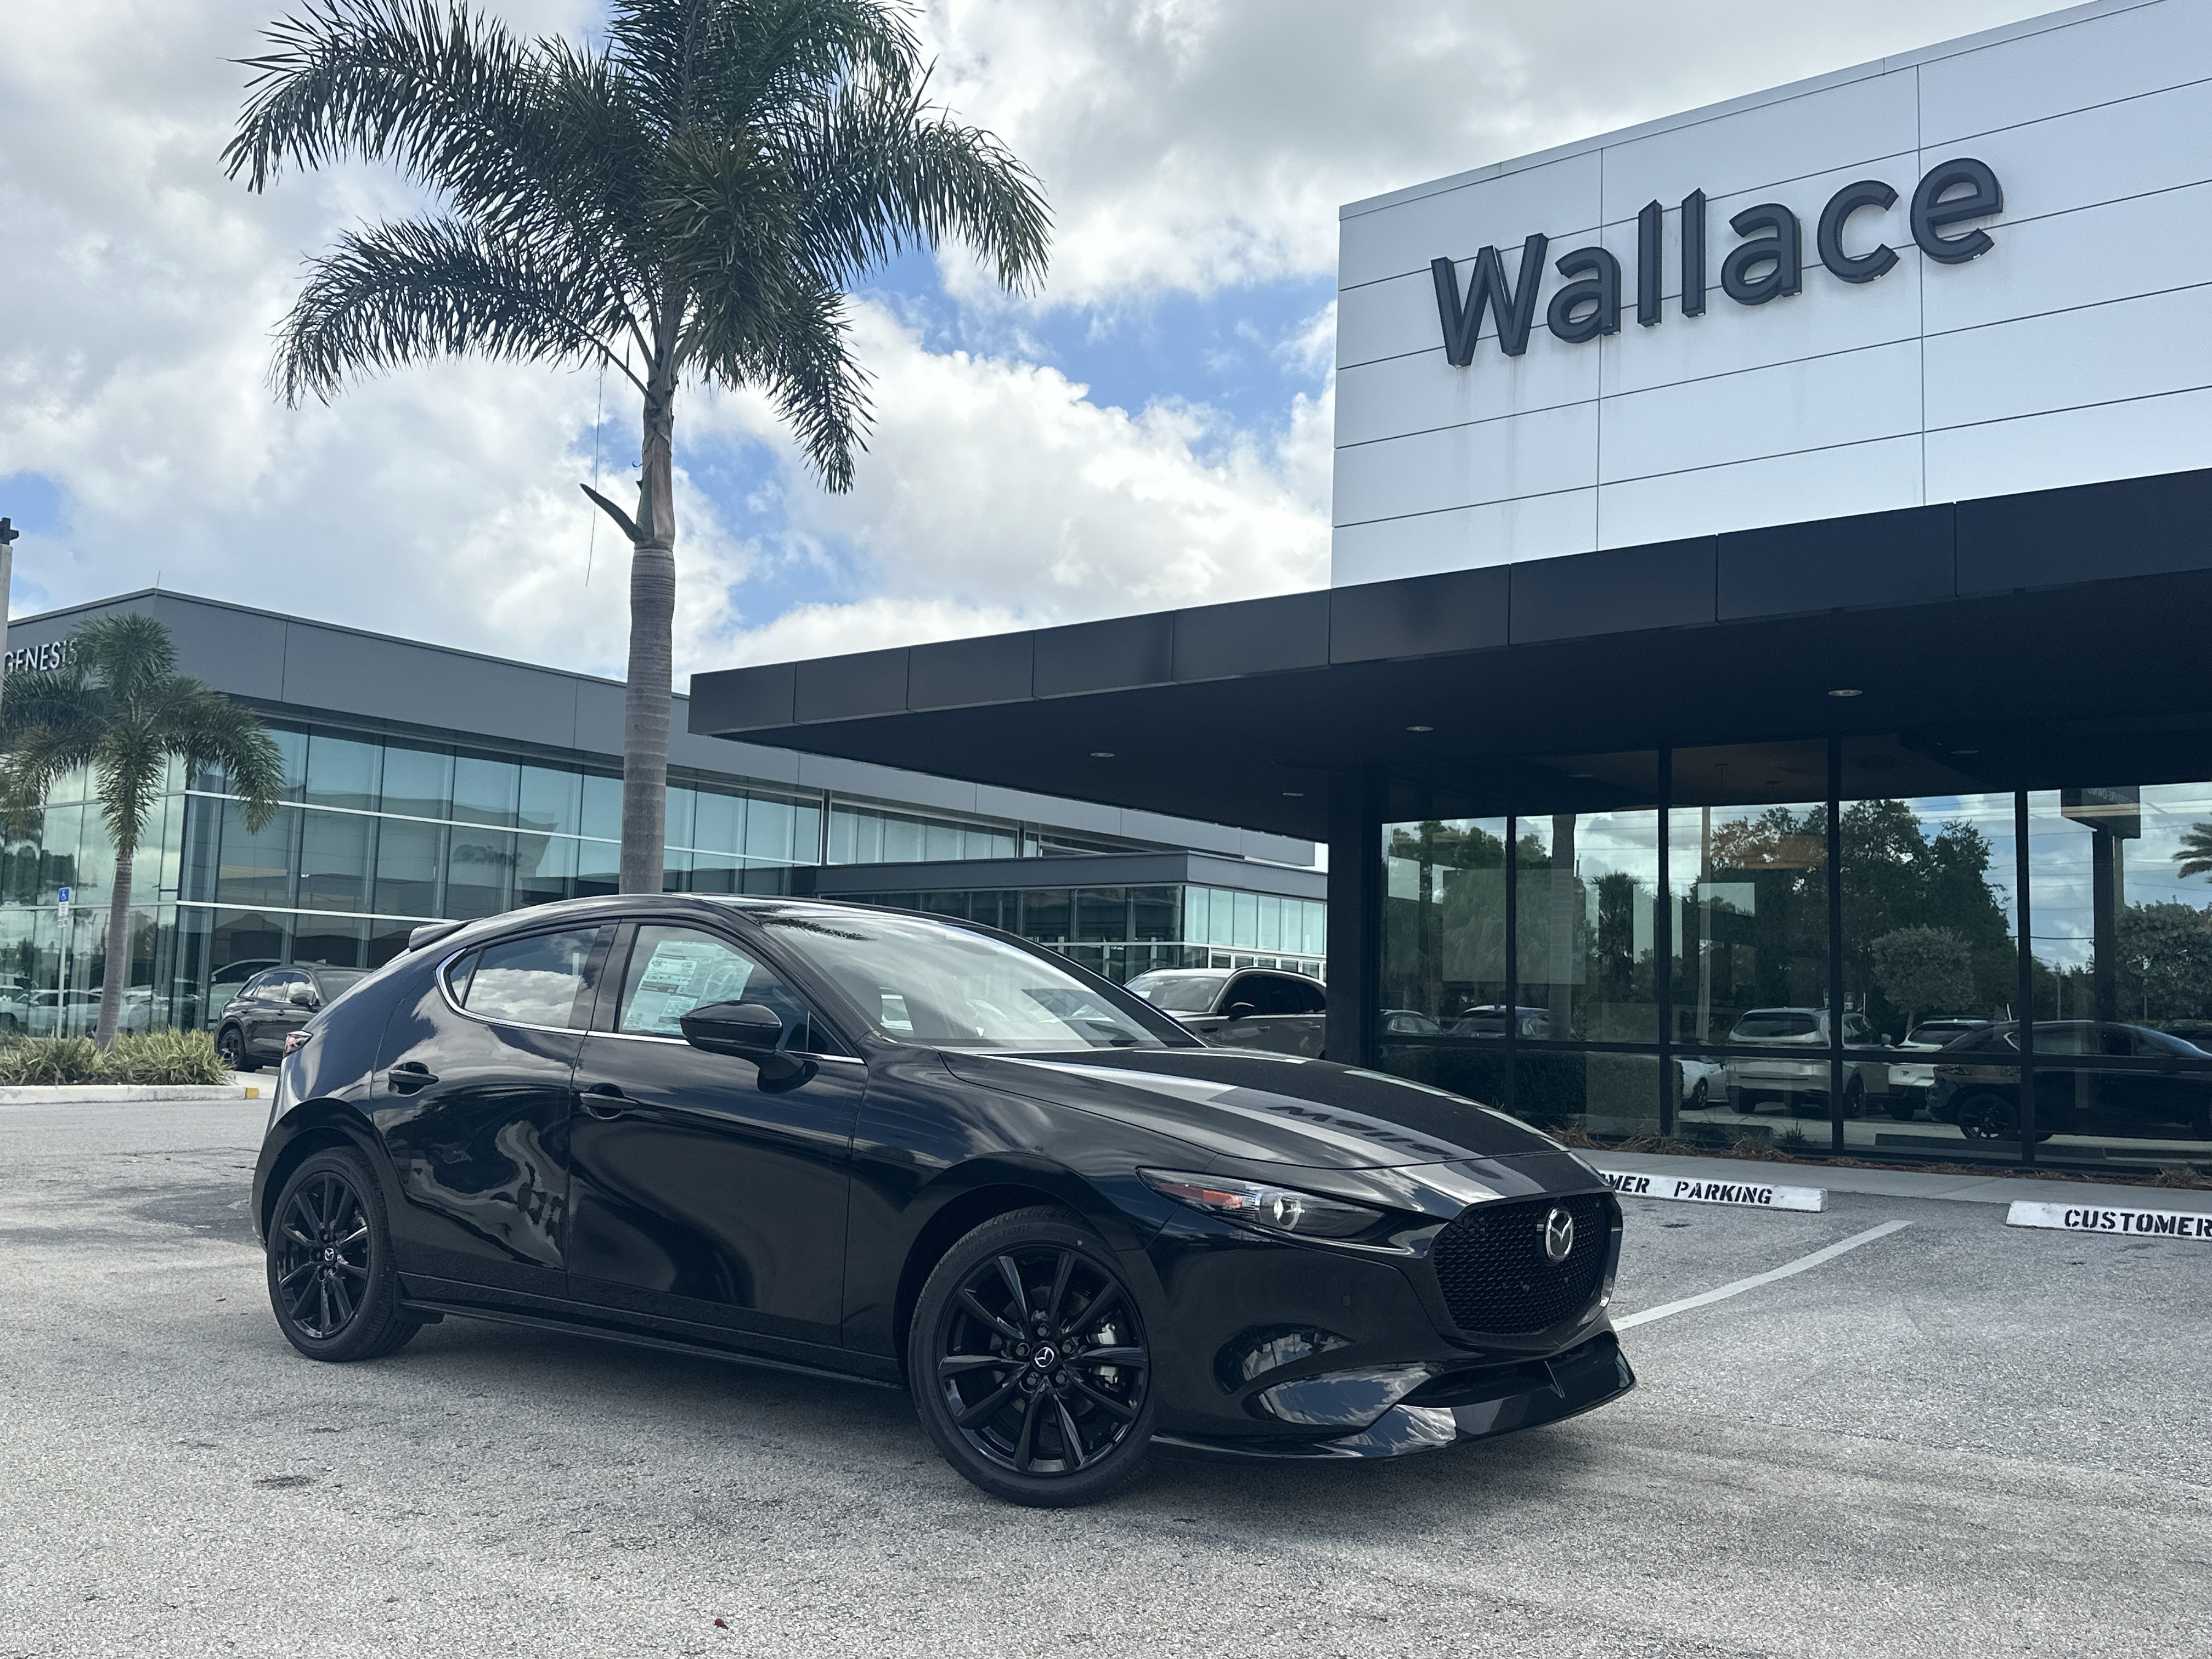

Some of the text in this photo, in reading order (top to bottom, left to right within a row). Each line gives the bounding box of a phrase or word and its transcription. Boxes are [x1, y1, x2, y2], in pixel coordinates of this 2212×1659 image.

[1430, 157, 2003, 368] Wallace
[5, 637, 77, 673] GENESIS
[1601, 1173, 1773, 1205] MER PARKING
[2064, 1209, 2212, 1237] CUSTOMER
